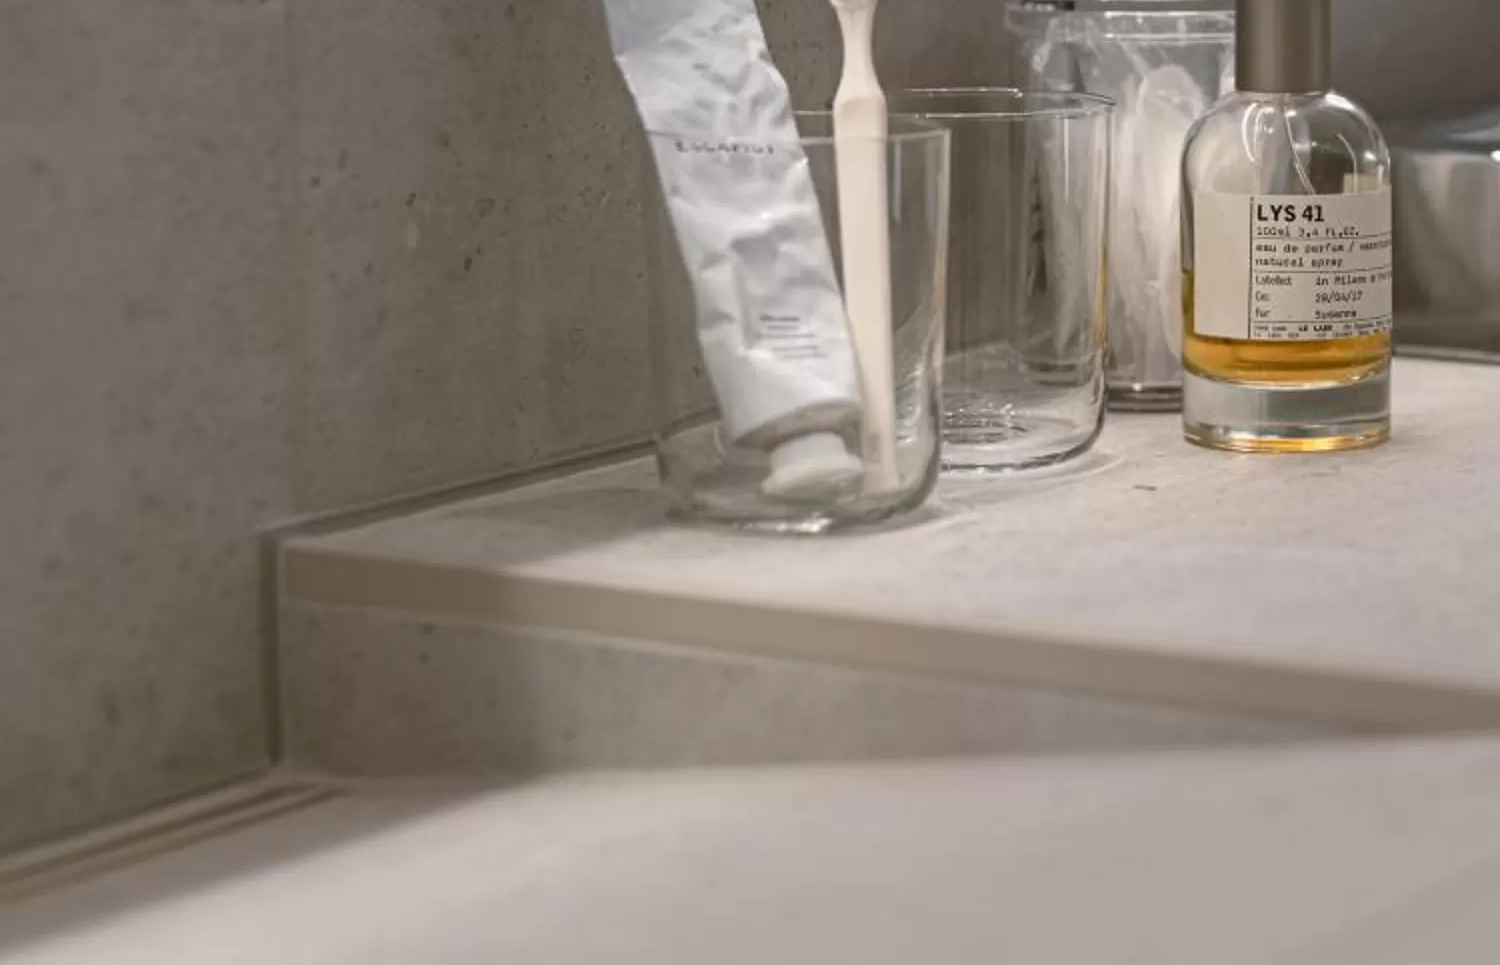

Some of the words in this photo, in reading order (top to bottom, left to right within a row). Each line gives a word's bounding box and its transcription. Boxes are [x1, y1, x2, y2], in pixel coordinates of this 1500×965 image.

[1257, 204, 1296, 222] LYS
[1302, 204, 1324, 222] 41
[1283, 243, 1298, 253] de
[1255, 257, 1303, 268] natural
